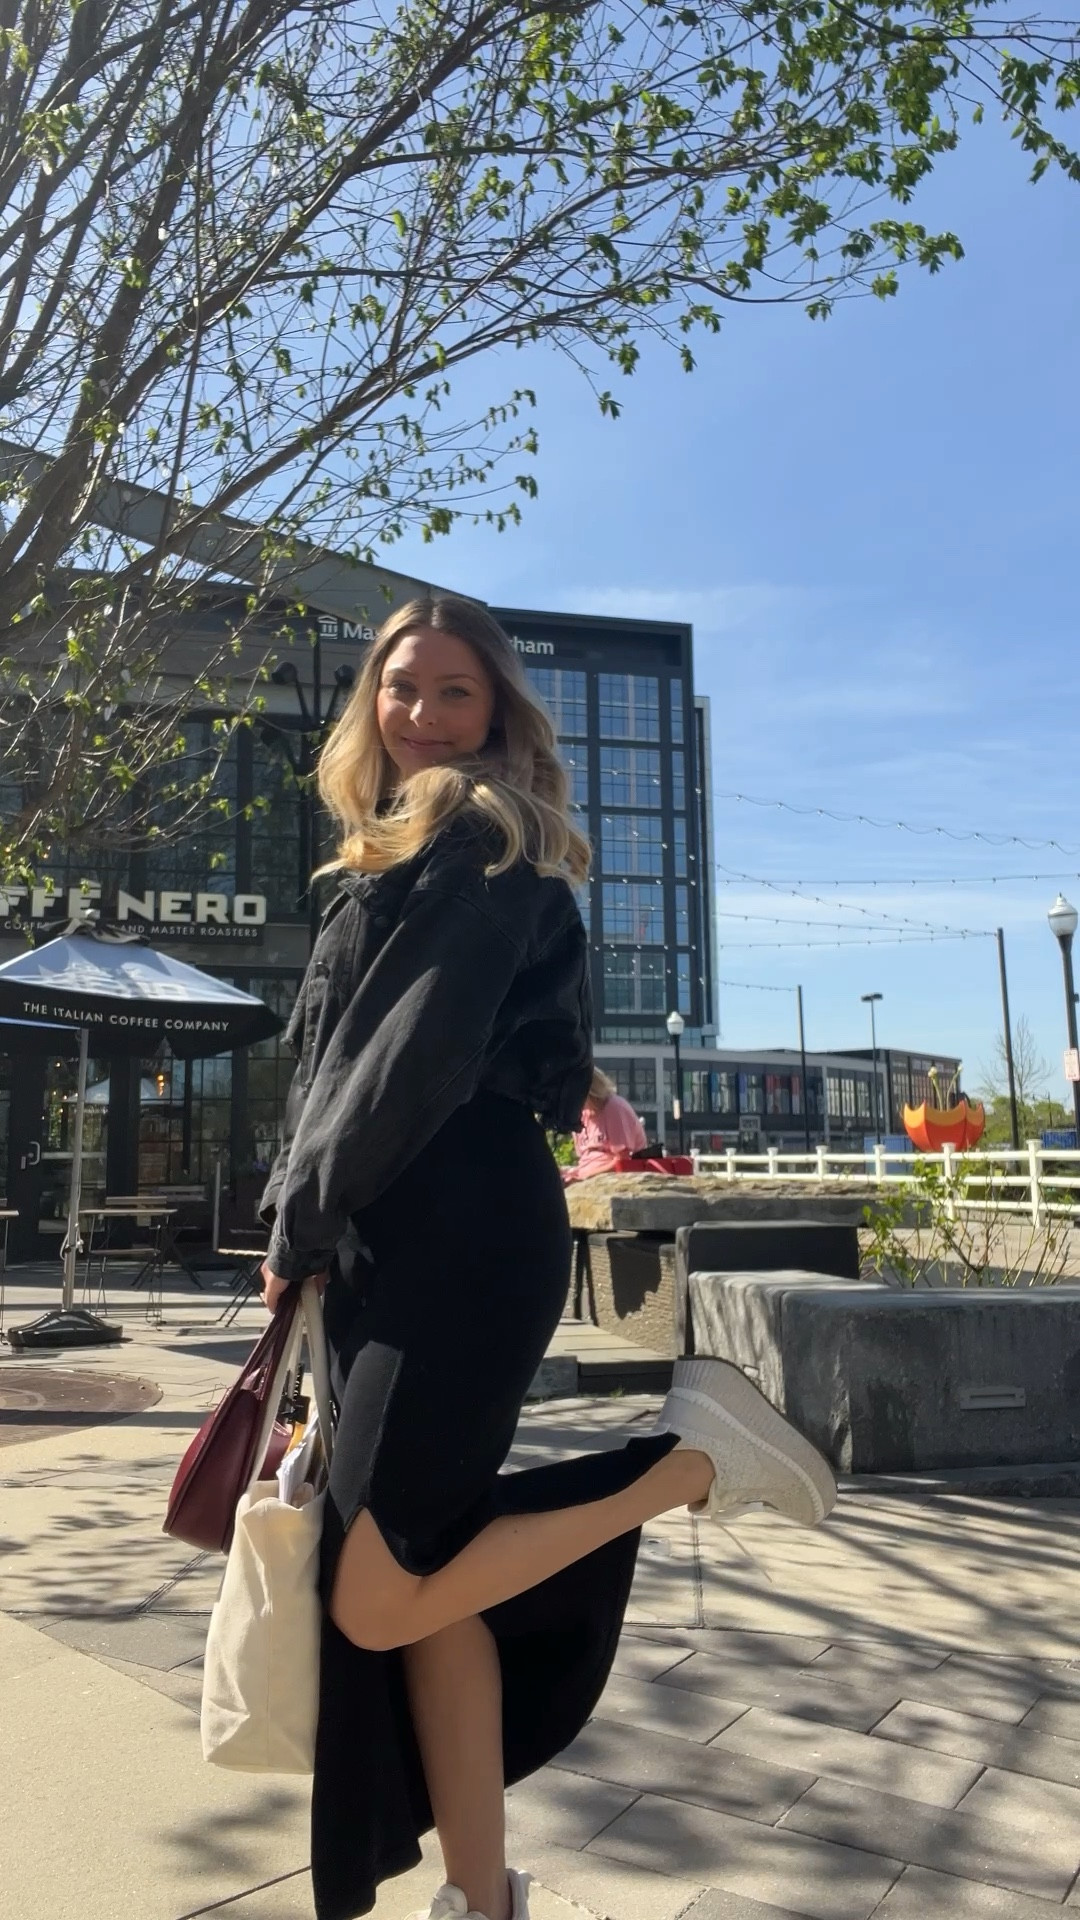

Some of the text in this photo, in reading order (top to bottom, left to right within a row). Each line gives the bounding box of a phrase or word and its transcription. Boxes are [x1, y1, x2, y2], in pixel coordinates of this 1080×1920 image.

[343, 622, 555, 655] Ma ham
[118, 890, 267, 925] NERO
[151, 926, 195, 935] MASTER
[201, 927, 258, 937] ROASTERS
[23, 1002, 229, 1031] THE ITALIAN COFFEE COMPANY
